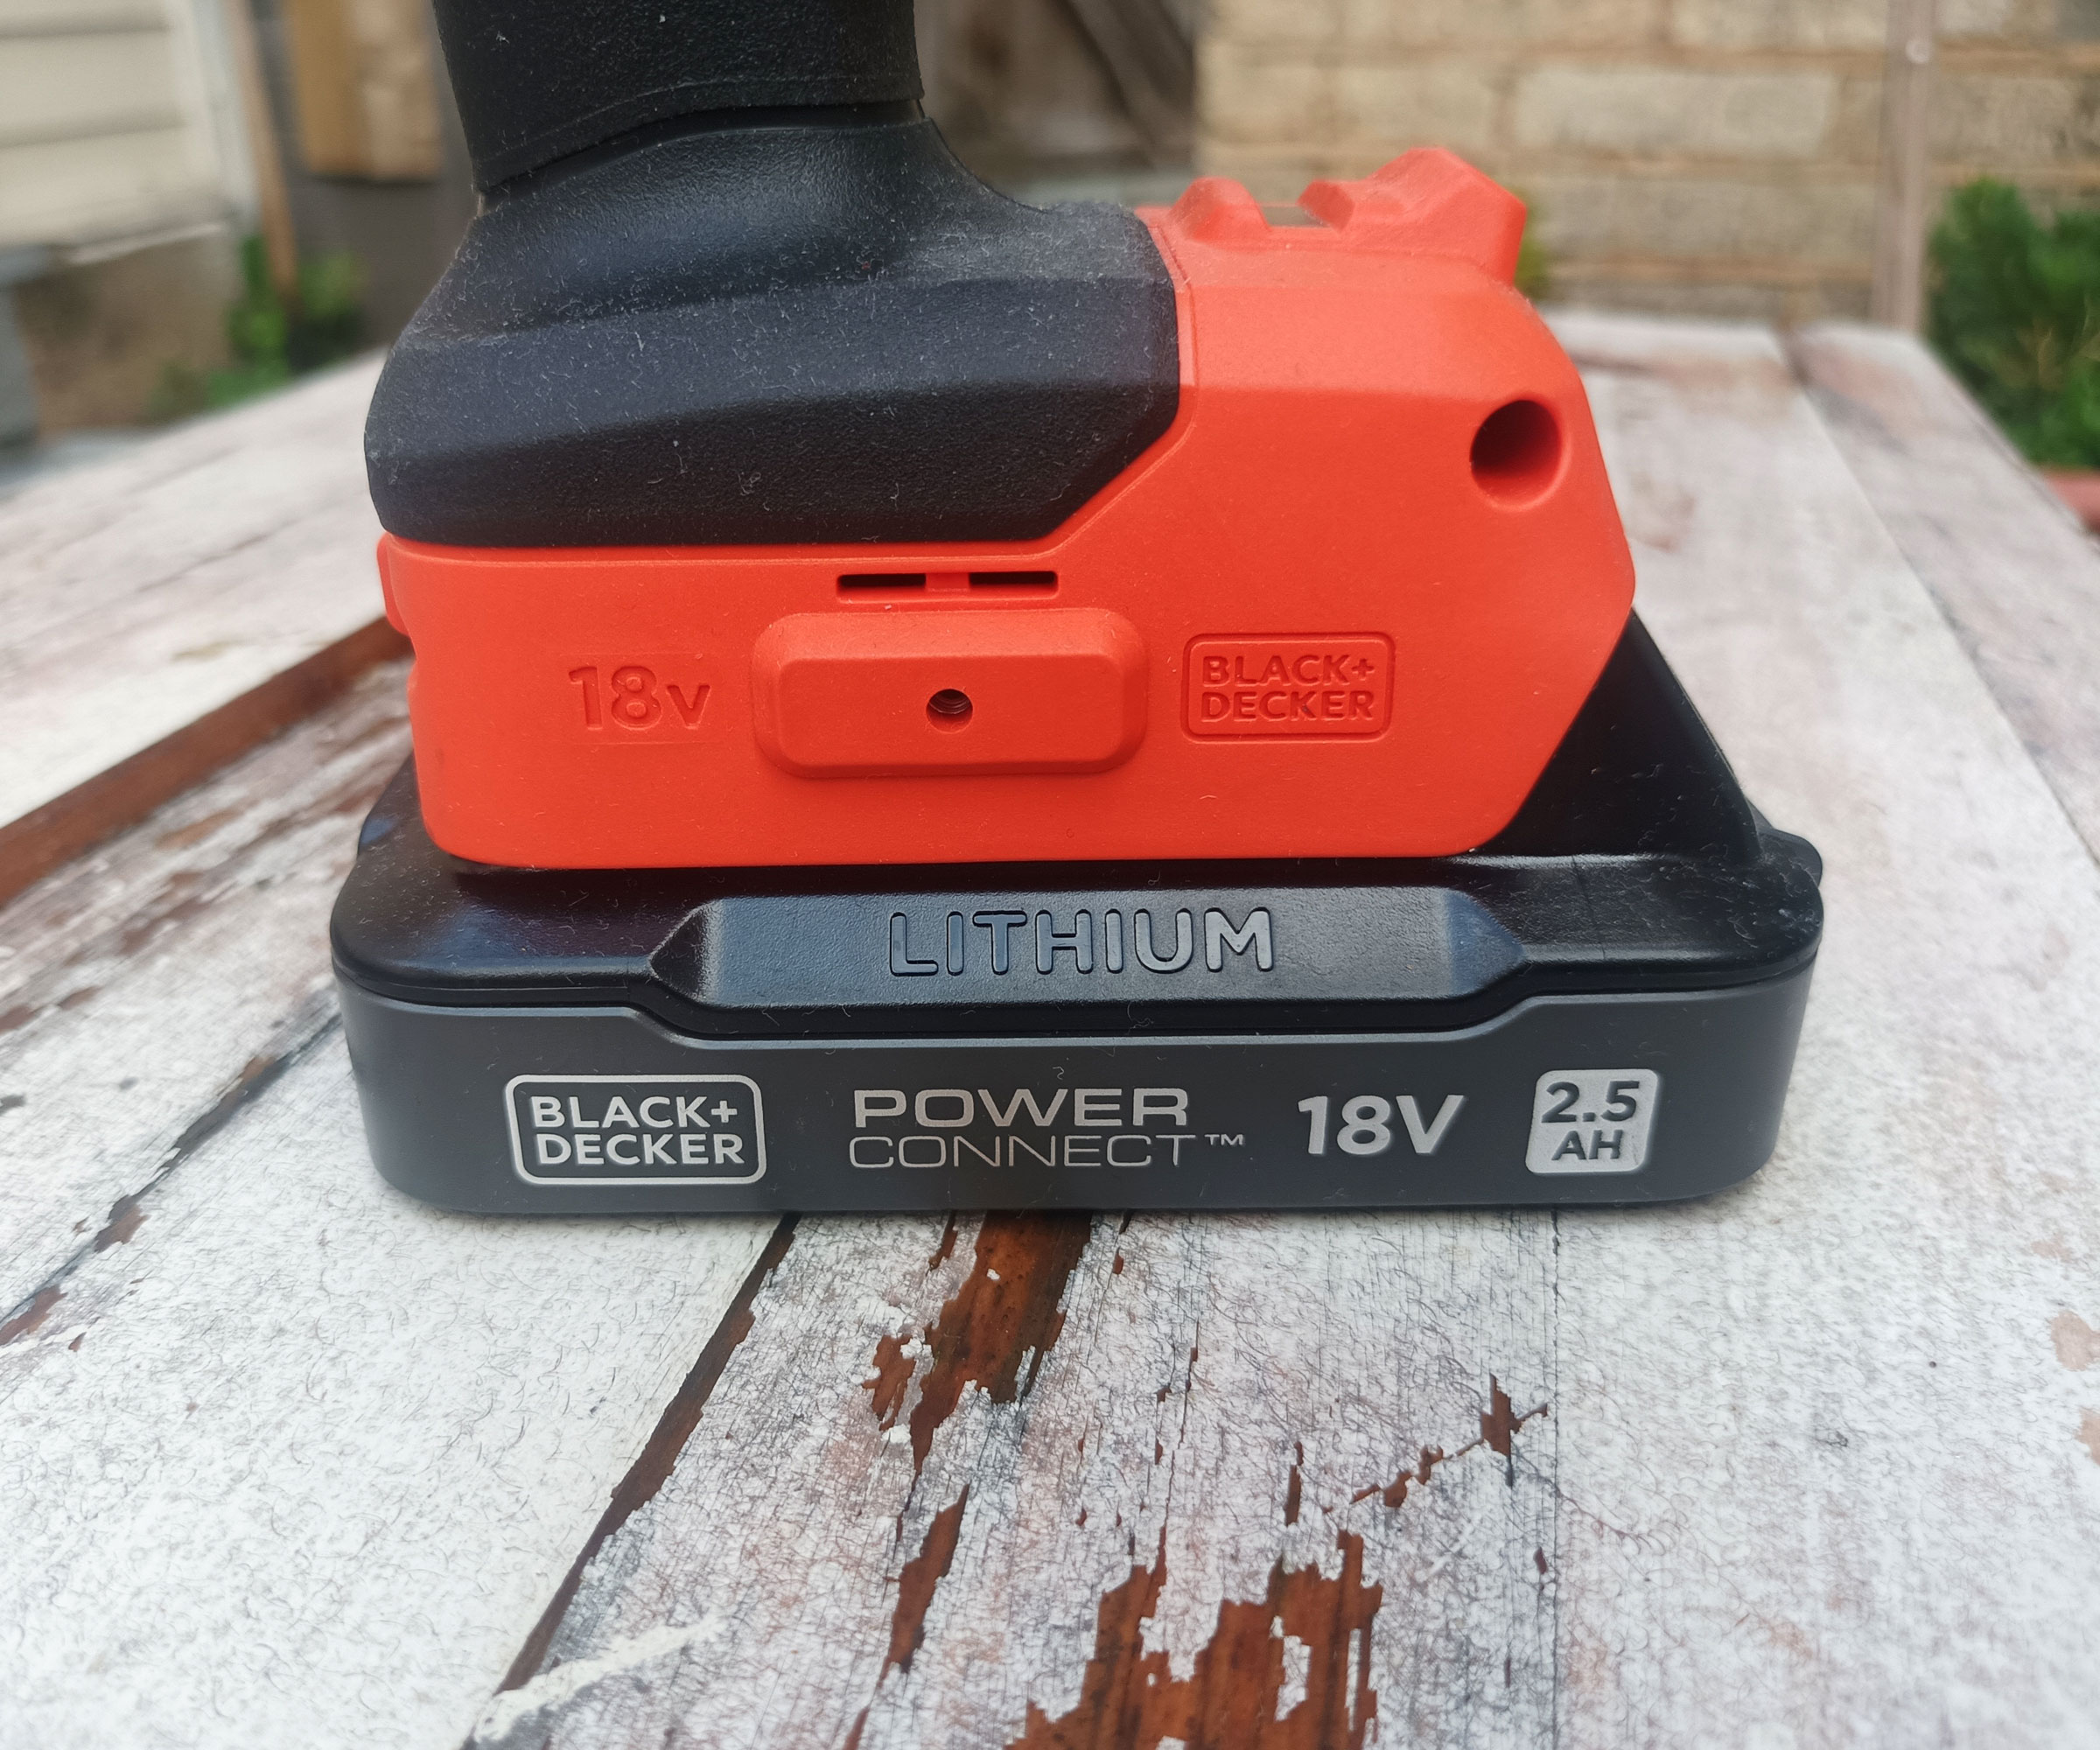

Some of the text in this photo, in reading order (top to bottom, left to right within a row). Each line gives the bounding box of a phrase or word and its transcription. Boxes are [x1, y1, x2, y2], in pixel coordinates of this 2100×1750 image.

[1202, 654, 1376, 687] BLACK+
[1200, 690, 1375, 722] DECKER
[890, 907, 1274, 976] LITHIUM
[531, 1096, 738, 1128] BLACK+
[853, 1088, 1188, 1128] POWER
[1541, 1080, 1640, 1124] 2.5
[1298, 1095, 1465, 1155] 18V
[536, 1133, 745, 1165] DECKER
[1551, 1130, 1623, 1161] AH
